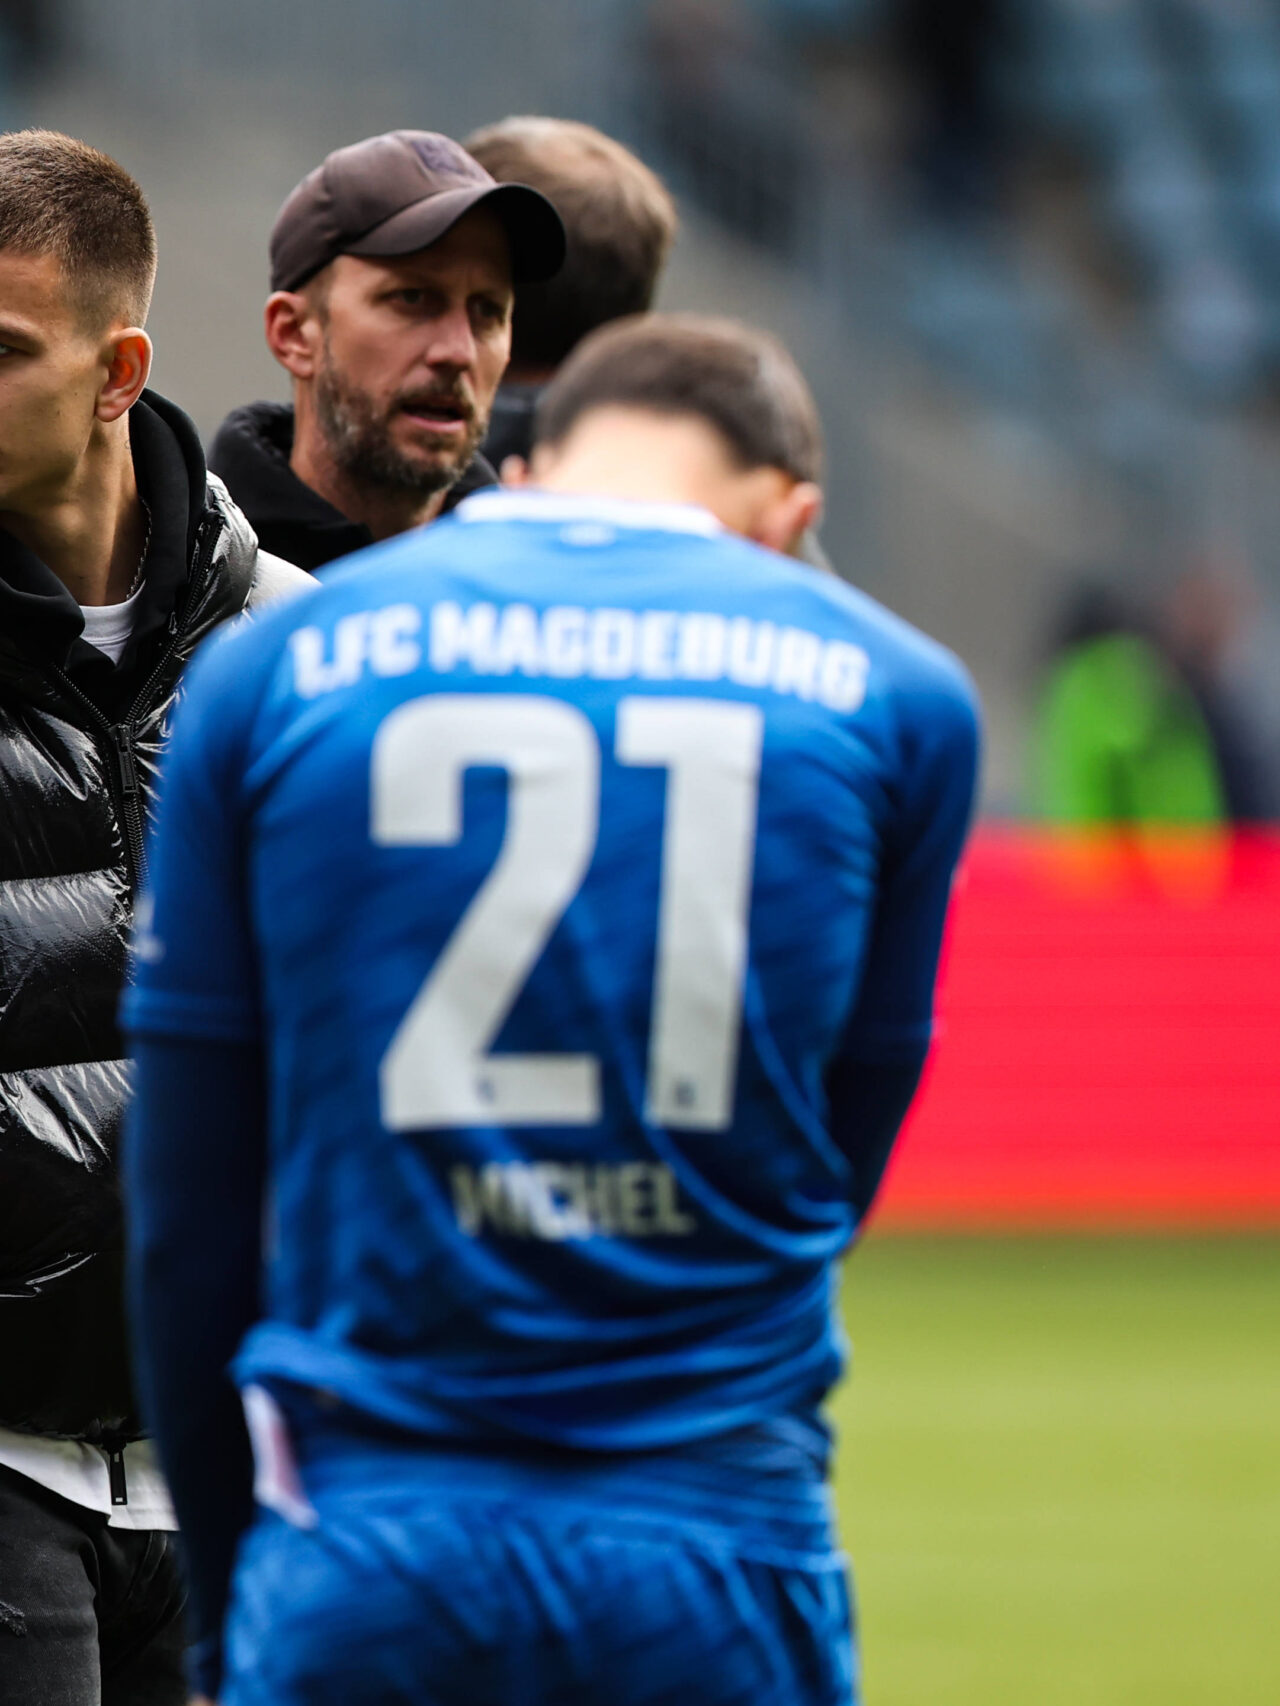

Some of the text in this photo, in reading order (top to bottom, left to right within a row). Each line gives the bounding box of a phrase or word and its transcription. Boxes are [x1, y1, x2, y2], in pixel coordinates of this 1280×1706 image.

[429, 600, 870, 714] MAGDEBURG
[370, 692, 764, 1132] 21
[451, 1160, 696, 1240] MICHEL
